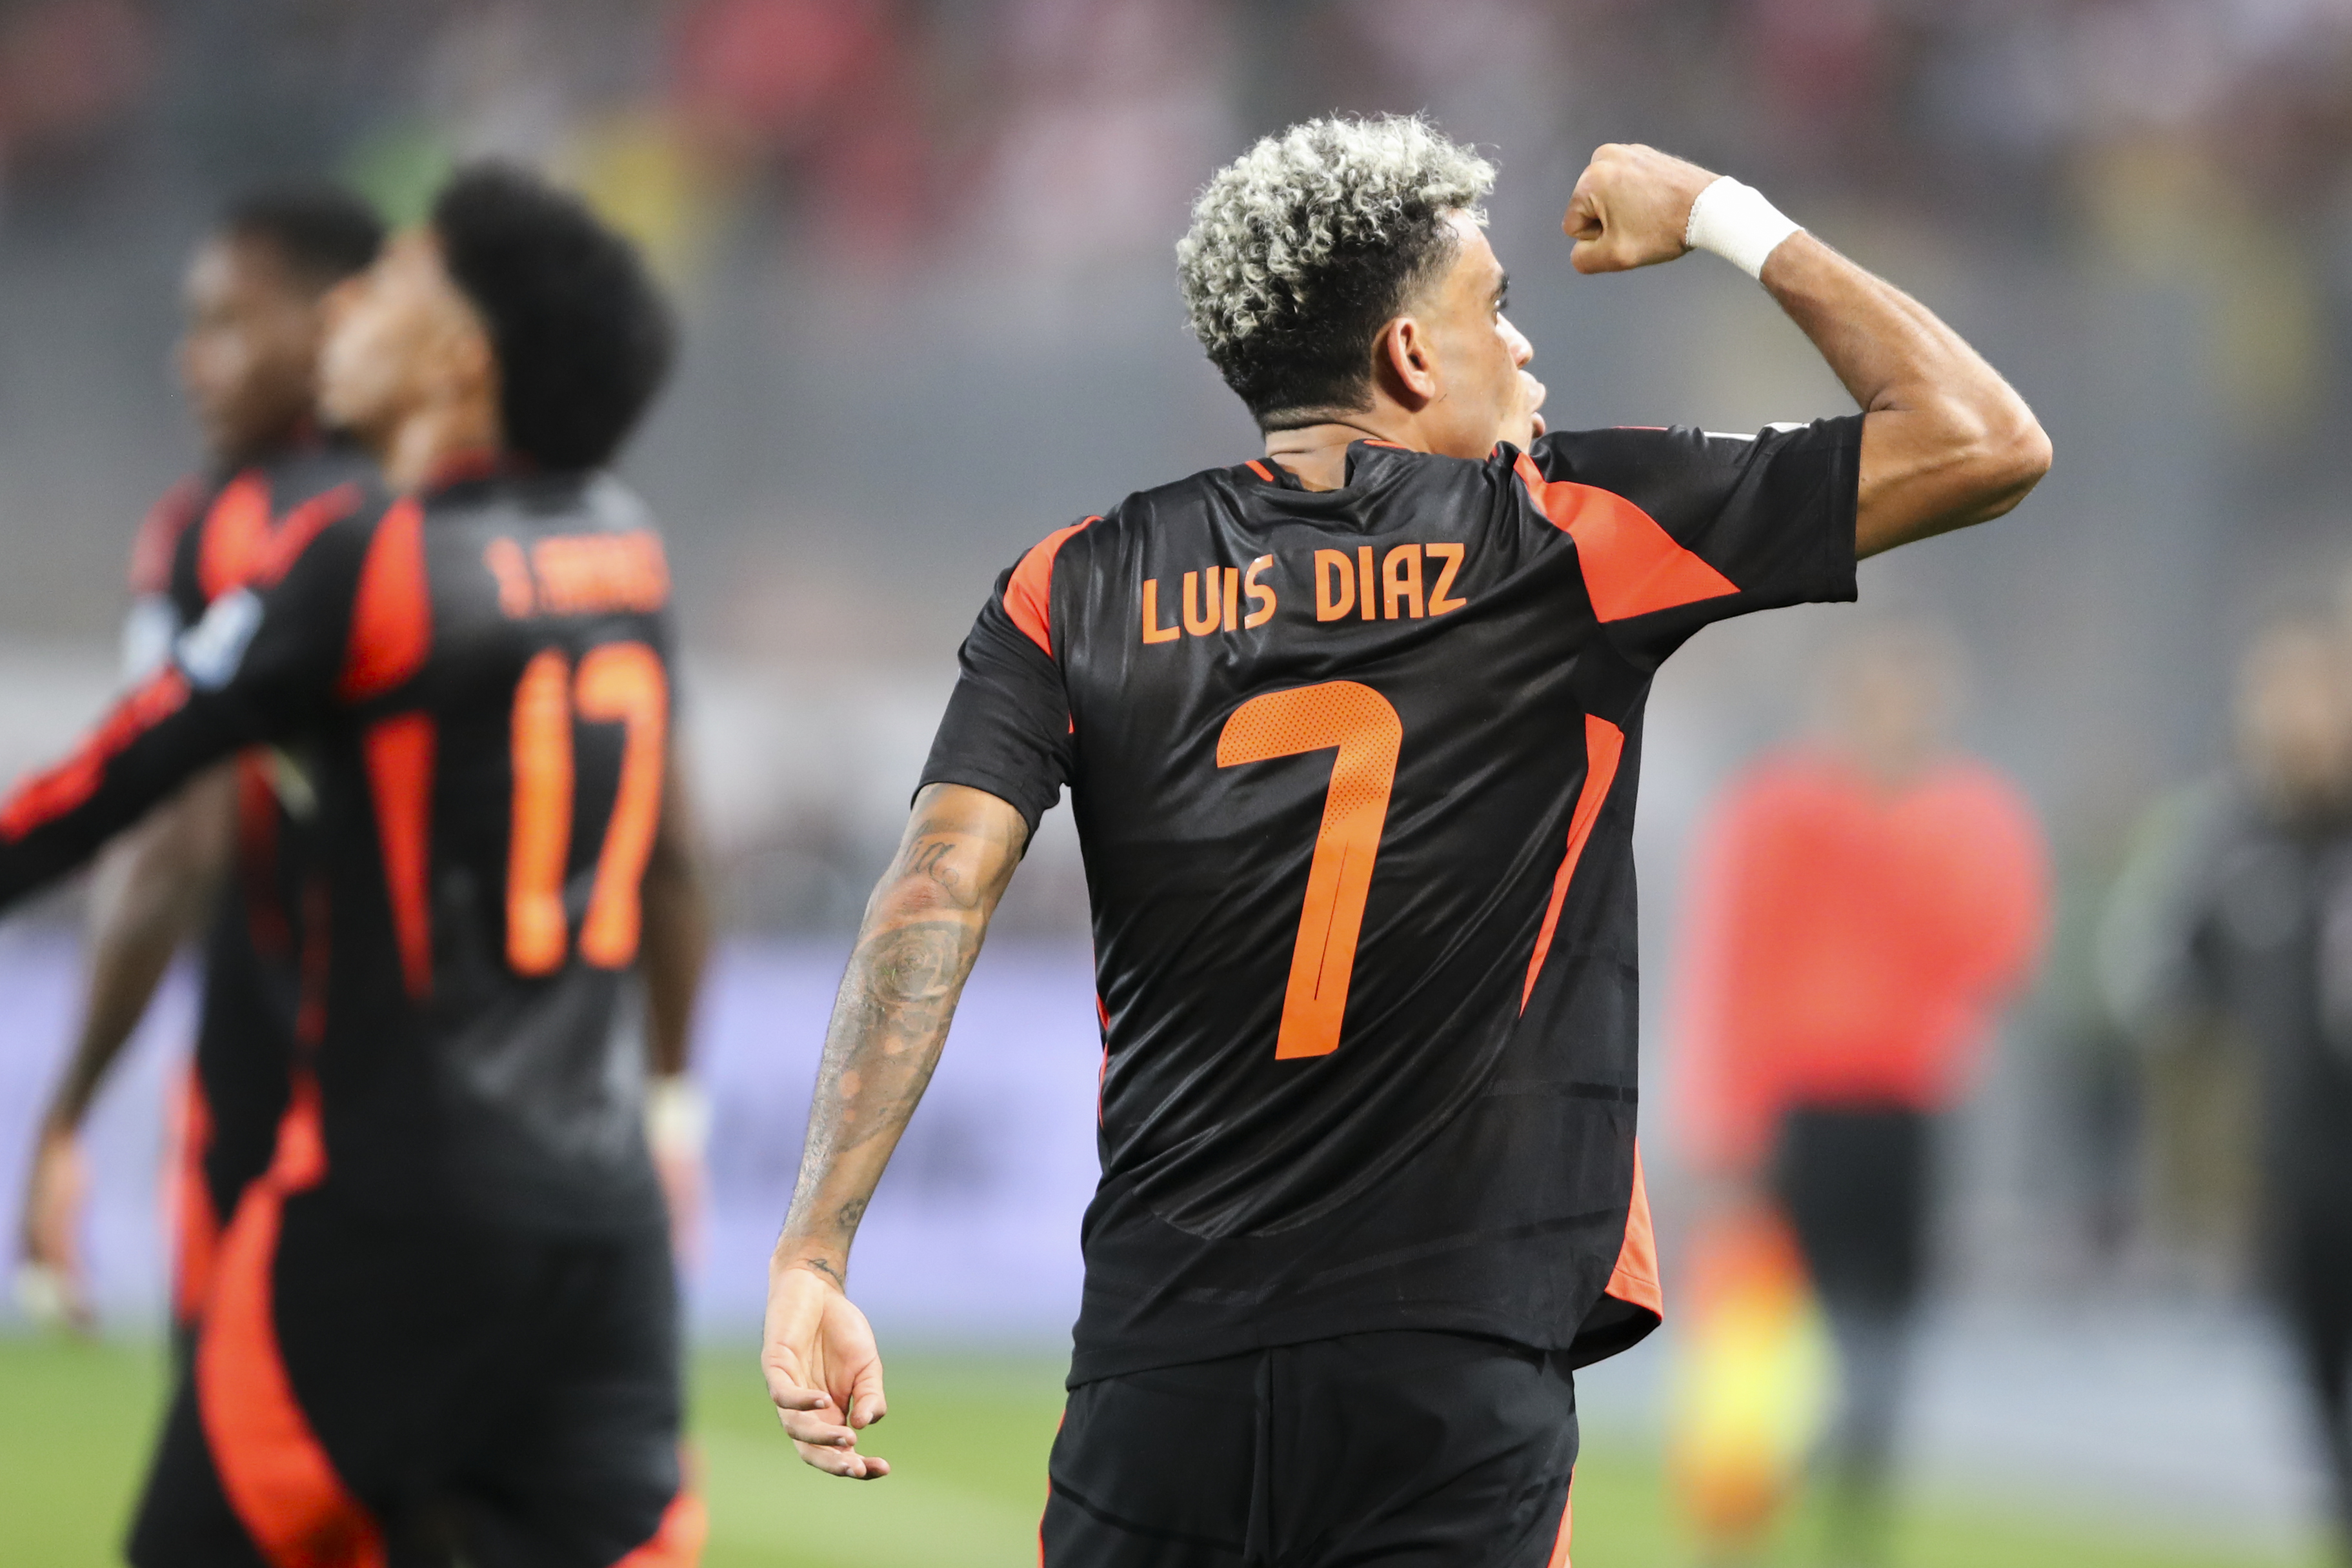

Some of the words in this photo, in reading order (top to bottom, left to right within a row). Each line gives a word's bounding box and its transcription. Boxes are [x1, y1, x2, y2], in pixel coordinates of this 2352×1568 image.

[1142, 553, 1278, 644] LUIS
[1314, 542, 1467, 622] DIAZ
[505, 641, 669, 976] 17
[1216, 679, 1403, 1060] 7
